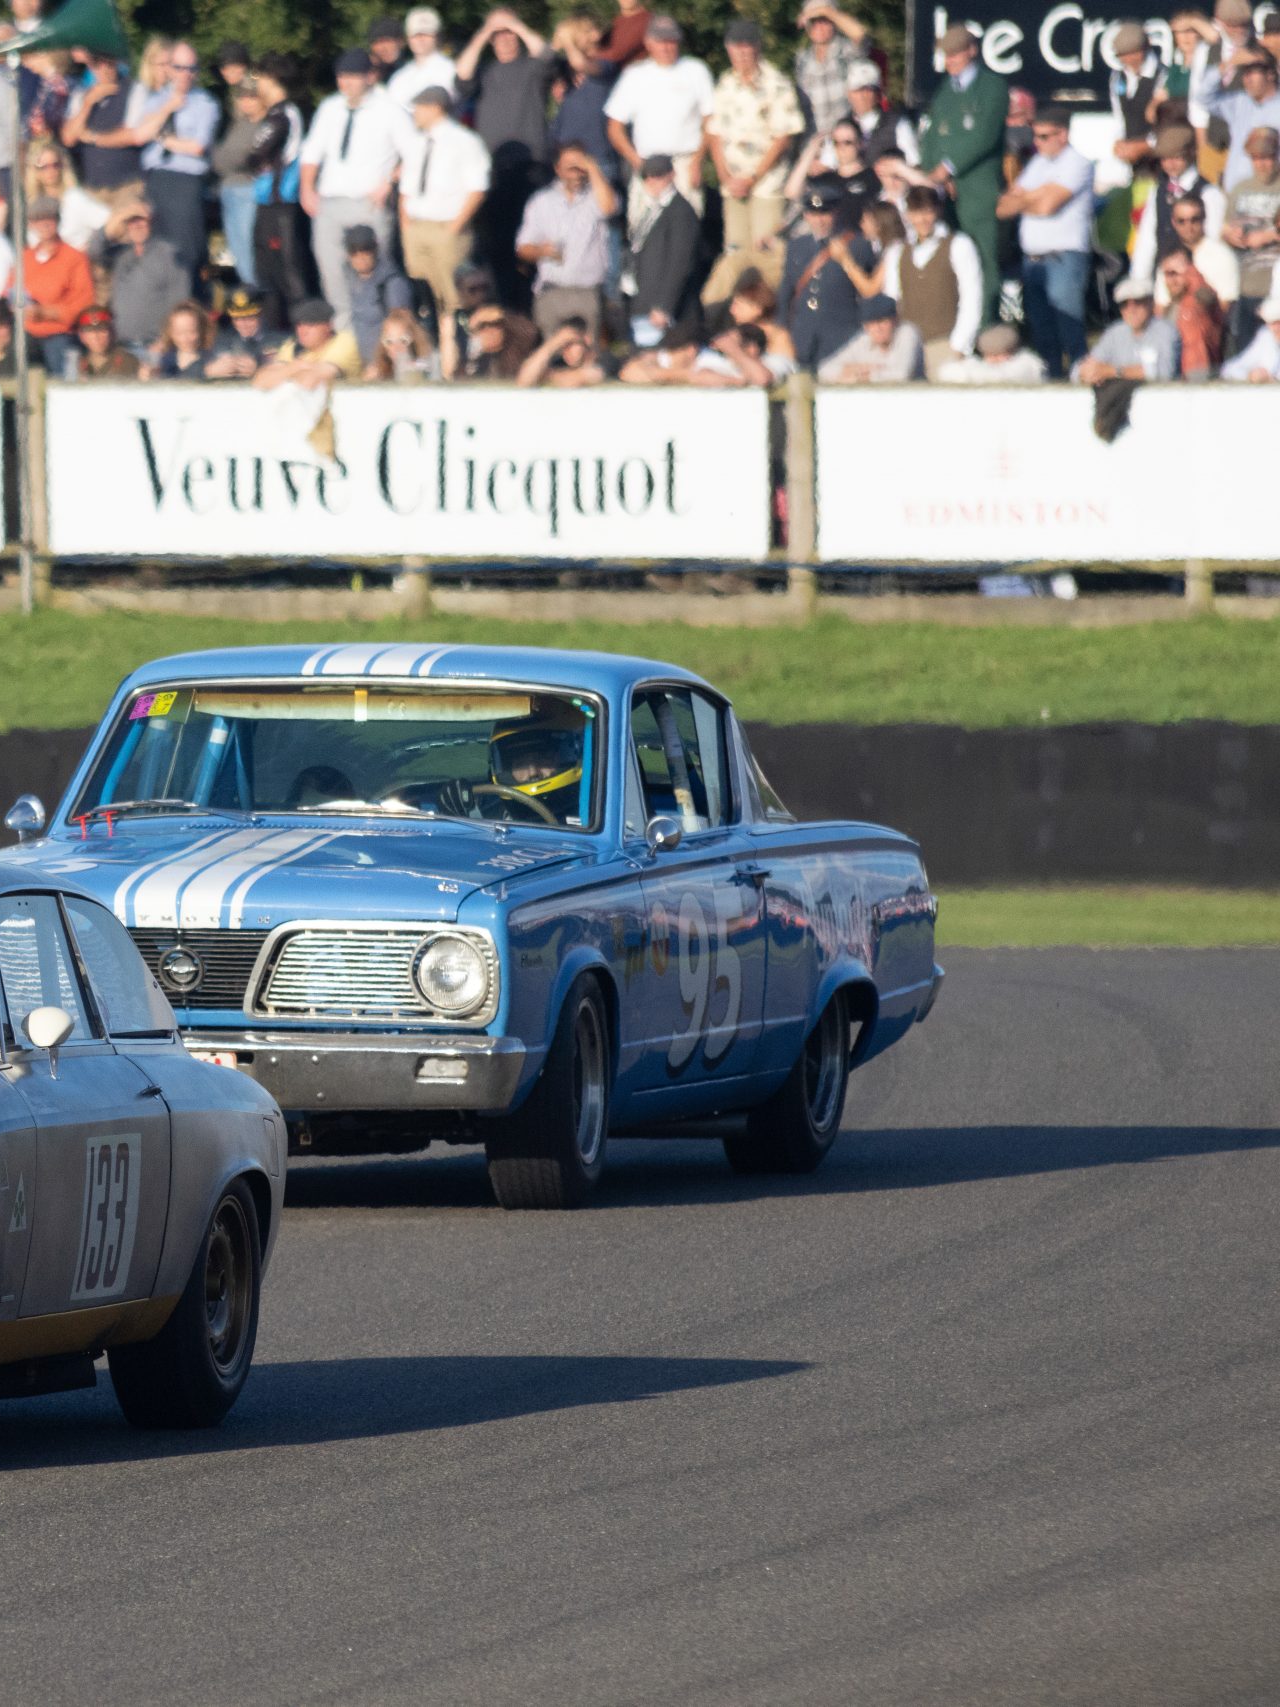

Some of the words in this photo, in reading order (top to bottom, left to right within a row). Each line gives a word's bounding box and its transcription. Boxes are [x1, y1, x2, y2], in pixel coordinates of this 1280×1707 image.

[933, 5, 1024, 74] Ie
[130, 416, 351, 515] Veuve
[374, 417, 689, 538] Clicquot
[902, 499, 1109, 526] EDMISTON
[116, 914, 270, 924] YMOUTH
[667, 887, 743, 1070] 95
[75, 1142, 130, 1293] 133
